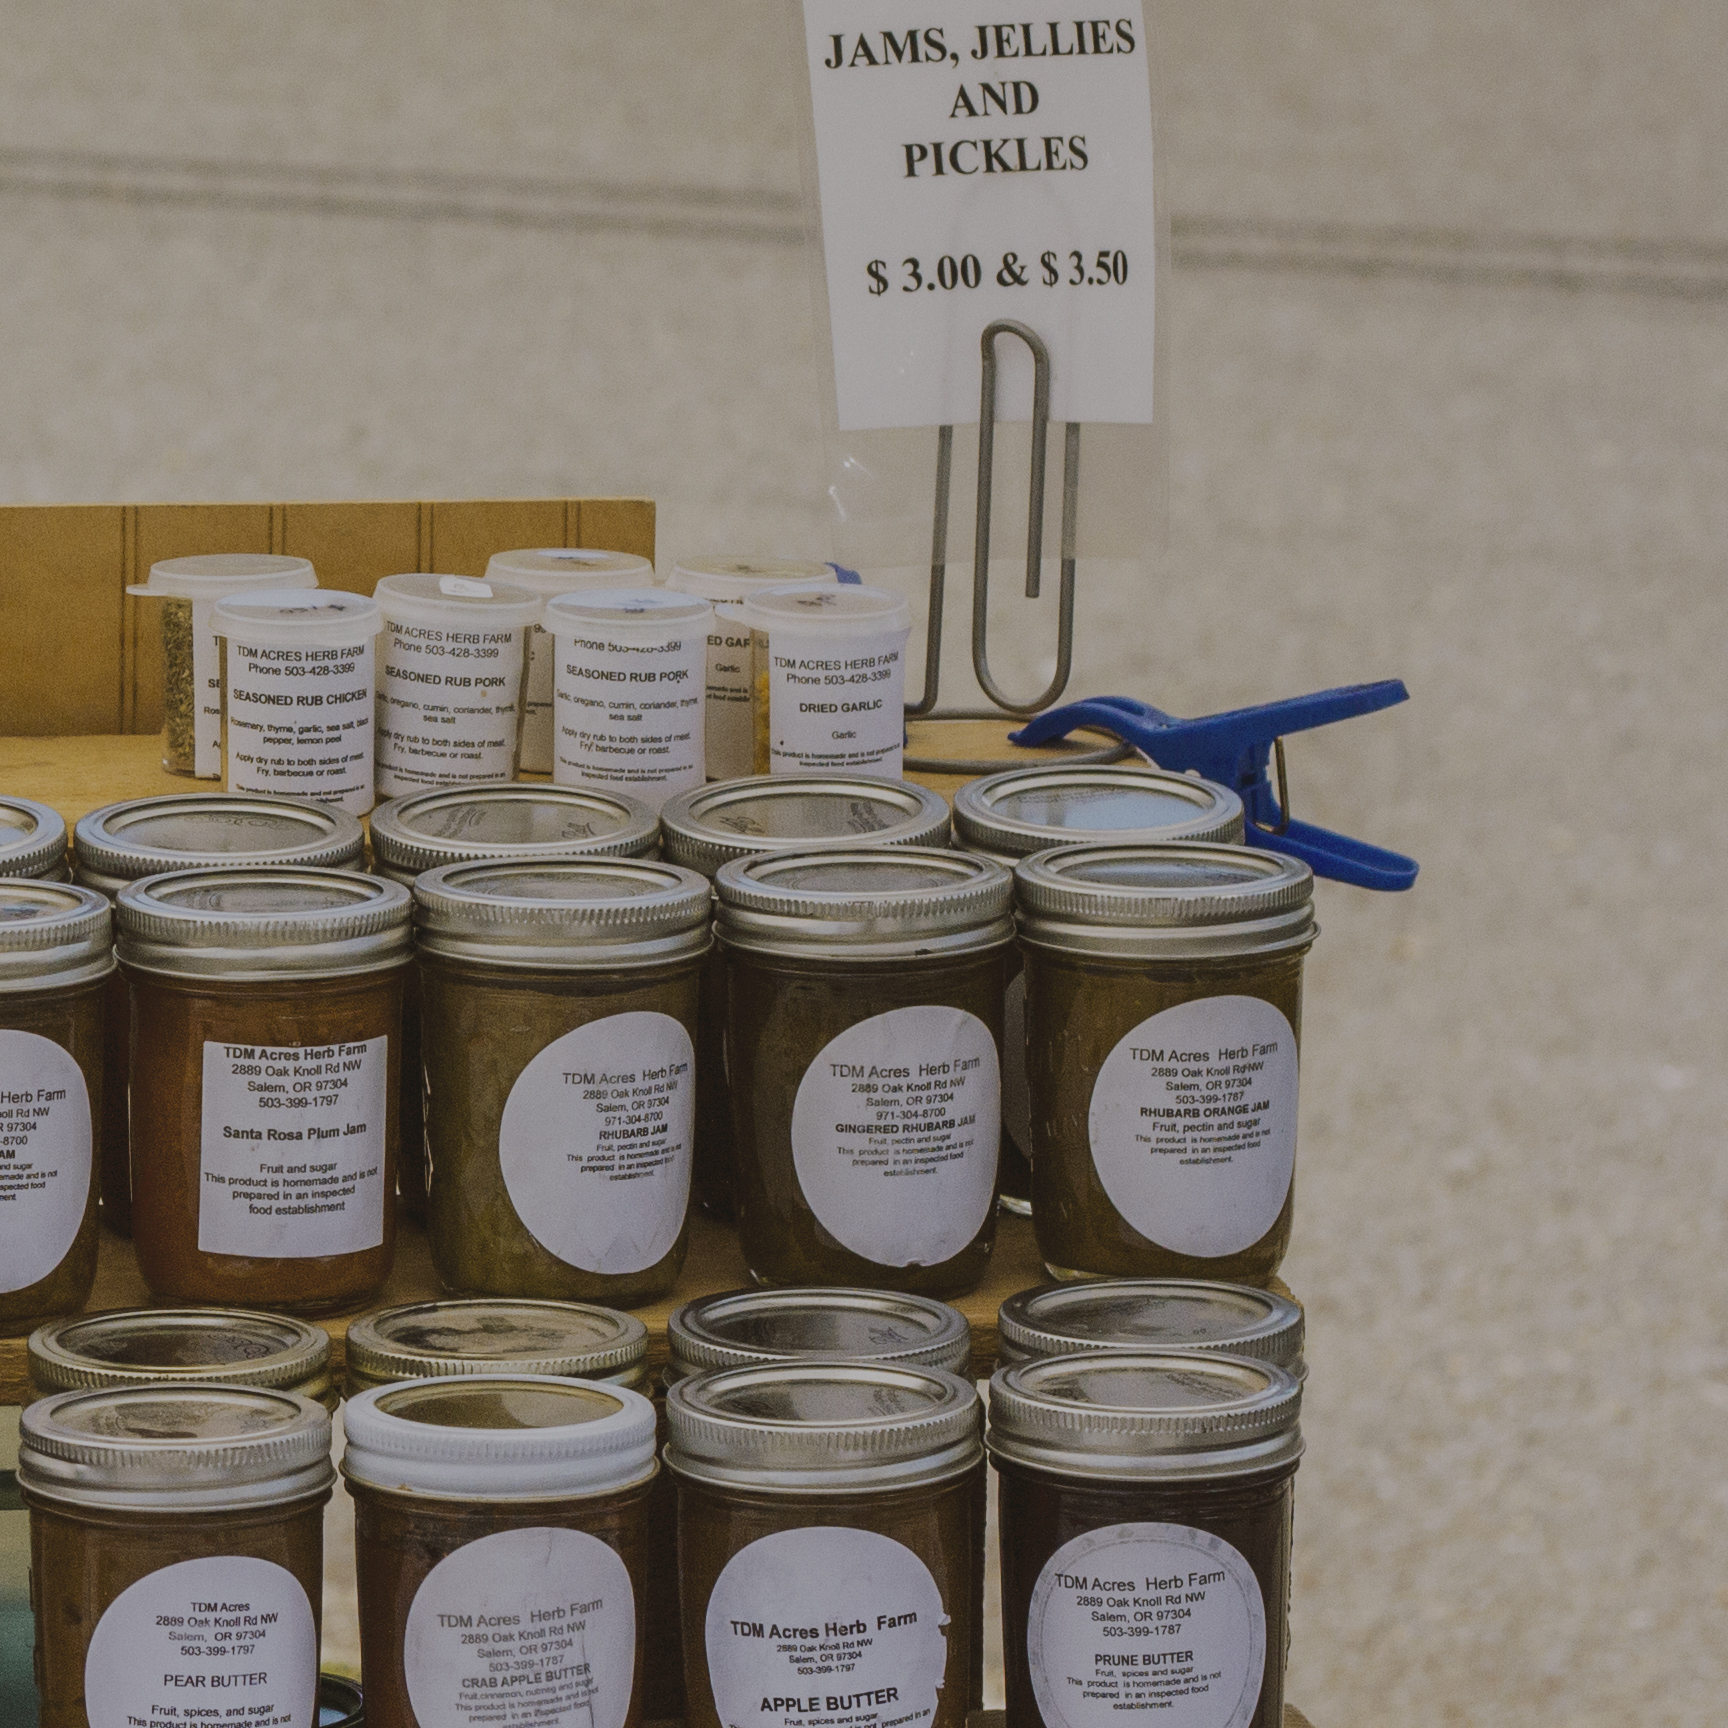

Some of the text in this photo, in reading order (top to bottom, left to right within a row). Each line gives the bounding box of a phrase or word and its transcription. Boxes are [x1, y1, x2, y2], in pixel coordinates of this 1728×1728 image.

[824, 18, 1136, 70] JAMS, JELLIES
[949, 81, 1040, 119] AND
[902, 135, 1090, 179] PICKLES
[995, 252, 1030, 287] &
[237, 644, 365, 662] TDM ACRES HERB FARM
[774, 651, 899, 671] TDM ACRES HERB FARM
[248, 662, 355, 677] Phone 503-428-3399
[385, 664, 506, 688] SEASONED RUB PORK
[233, 688, 367, 707] SEASONED RUB CHICKEN
[799, 699, 883, 713] DRIED GARLIC
[223, 1043, 367, 1061] TDM Acres Herb Farm
[259, 1094, 339, 1109] 503-399-1797
[1140, 1100, 1270, 1118] RHUBARB ORANGE JAM
[223, 1123, 367, 1141] Santa Rosa Plum Jam
[599, 1123, 668, 1140] RHUBARB JAM
[835, 1114, 976, 1134] GINGERED RHUBARB JAM
[1076, 1591, 1206, 1608] 2889 Oak Knoll Rd NW
[730, 1612, 918, 1639] TDM Acres Herb Farm
[1095, 1650, 1194, 1666] PRUNE BUTTER
[163, 1672, 268, 1688] PEAR BUTTER
[462, 1662, 591, 1689] CRAB APPLE BUTTER
[760, 1687, 899, 1713] APPLE BUTTER
